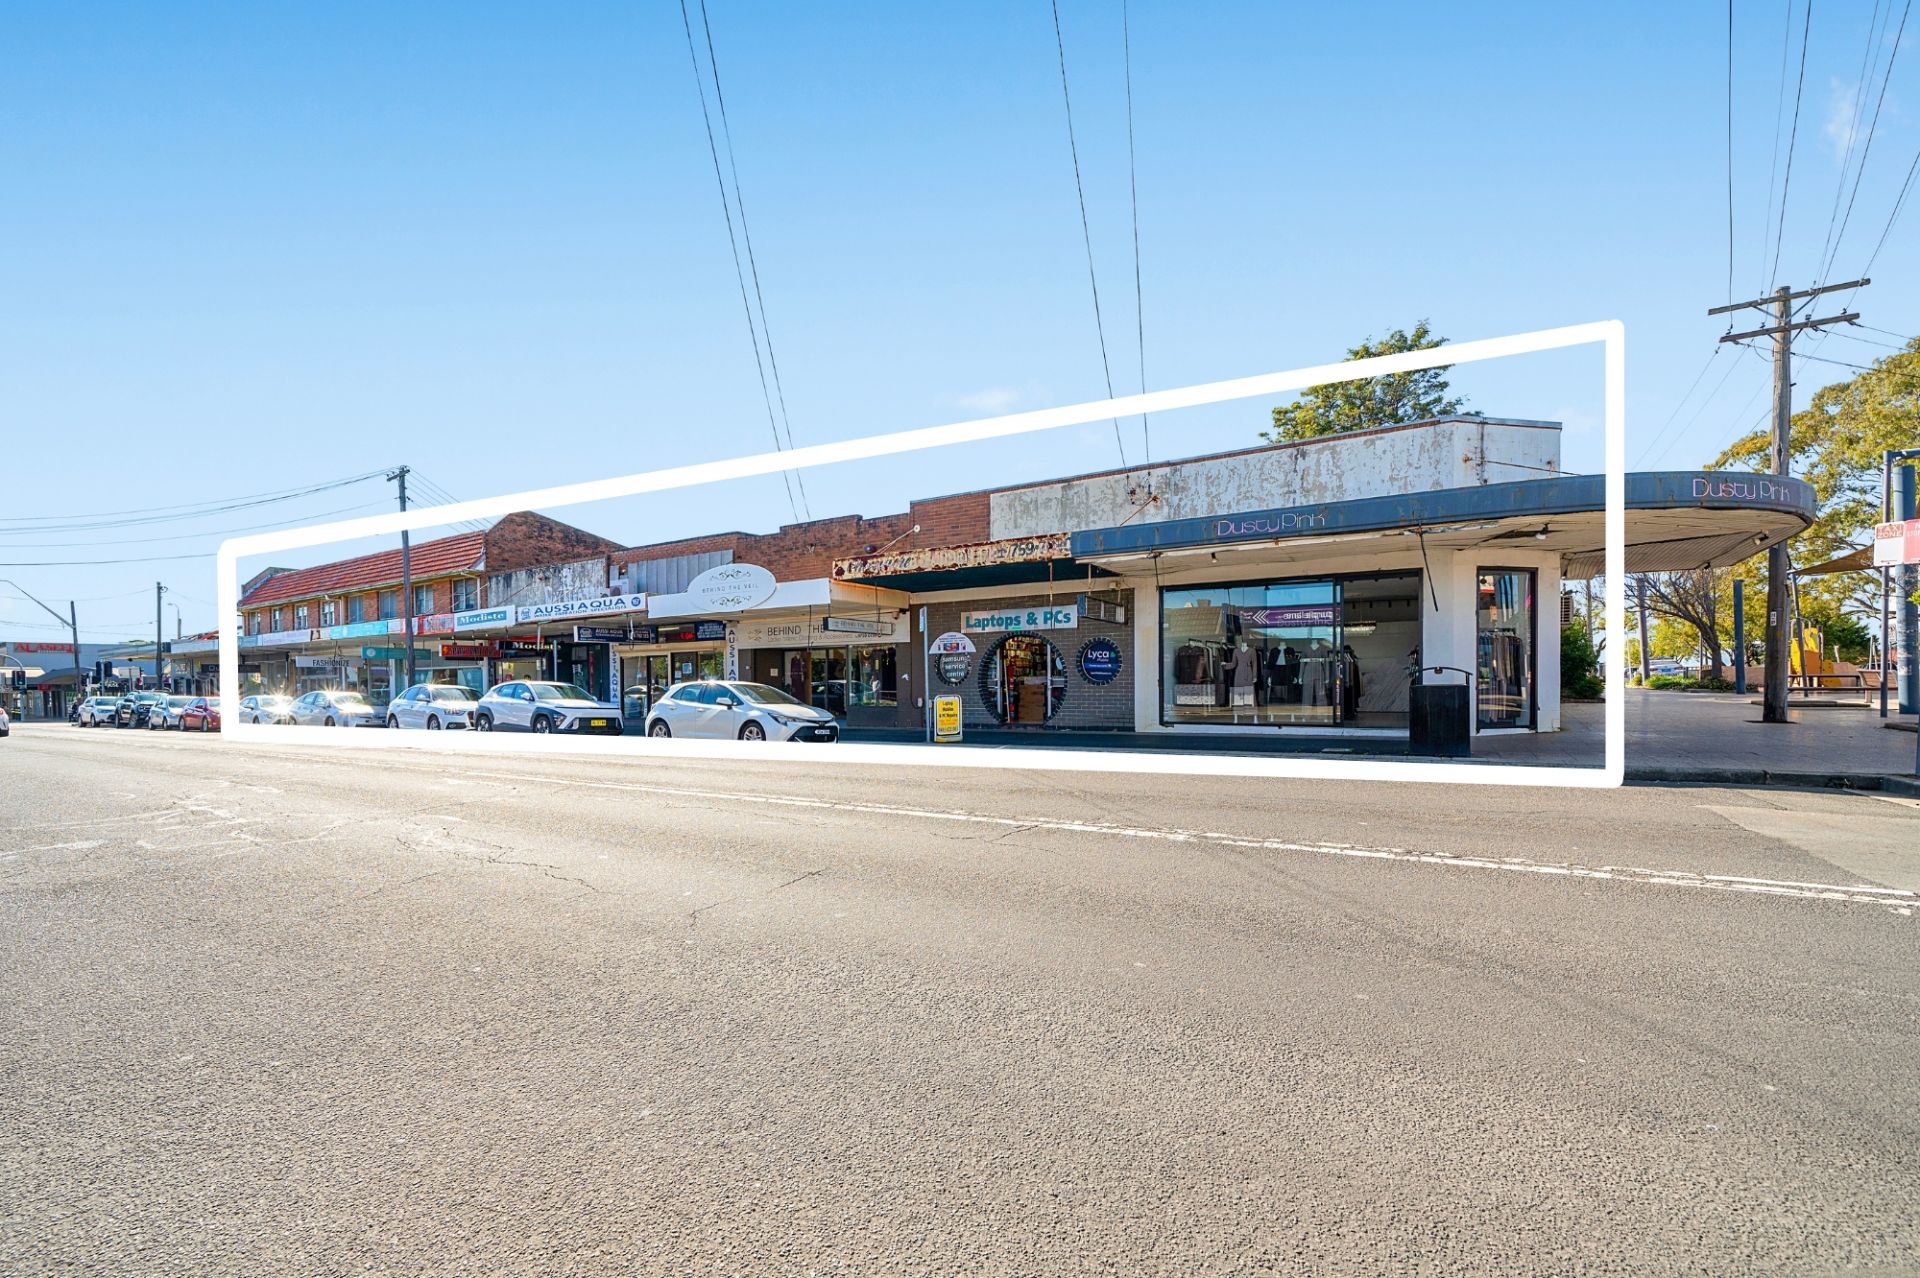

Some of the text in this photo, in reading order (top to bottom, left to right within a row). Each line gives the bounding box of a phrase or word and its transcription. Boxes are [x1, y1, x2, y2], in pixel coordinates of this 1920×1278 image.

[1692, 478, 1756, 500] Dusty
[1217, 513, 1325, 536] Dusty Pink
[534, 598, 626, 615] AUSSI AQUA
[458, 612, 504, 625] Modiste
[965, 609, 1071, 631] Laptops & PCs
[767, 625, 801, 636] BEHIND
[728, 629, 736, 666] AUSSI
[1087, 650, 1110, 660] Lyca
[312, 659, 350, 667] FASHIONIZE
